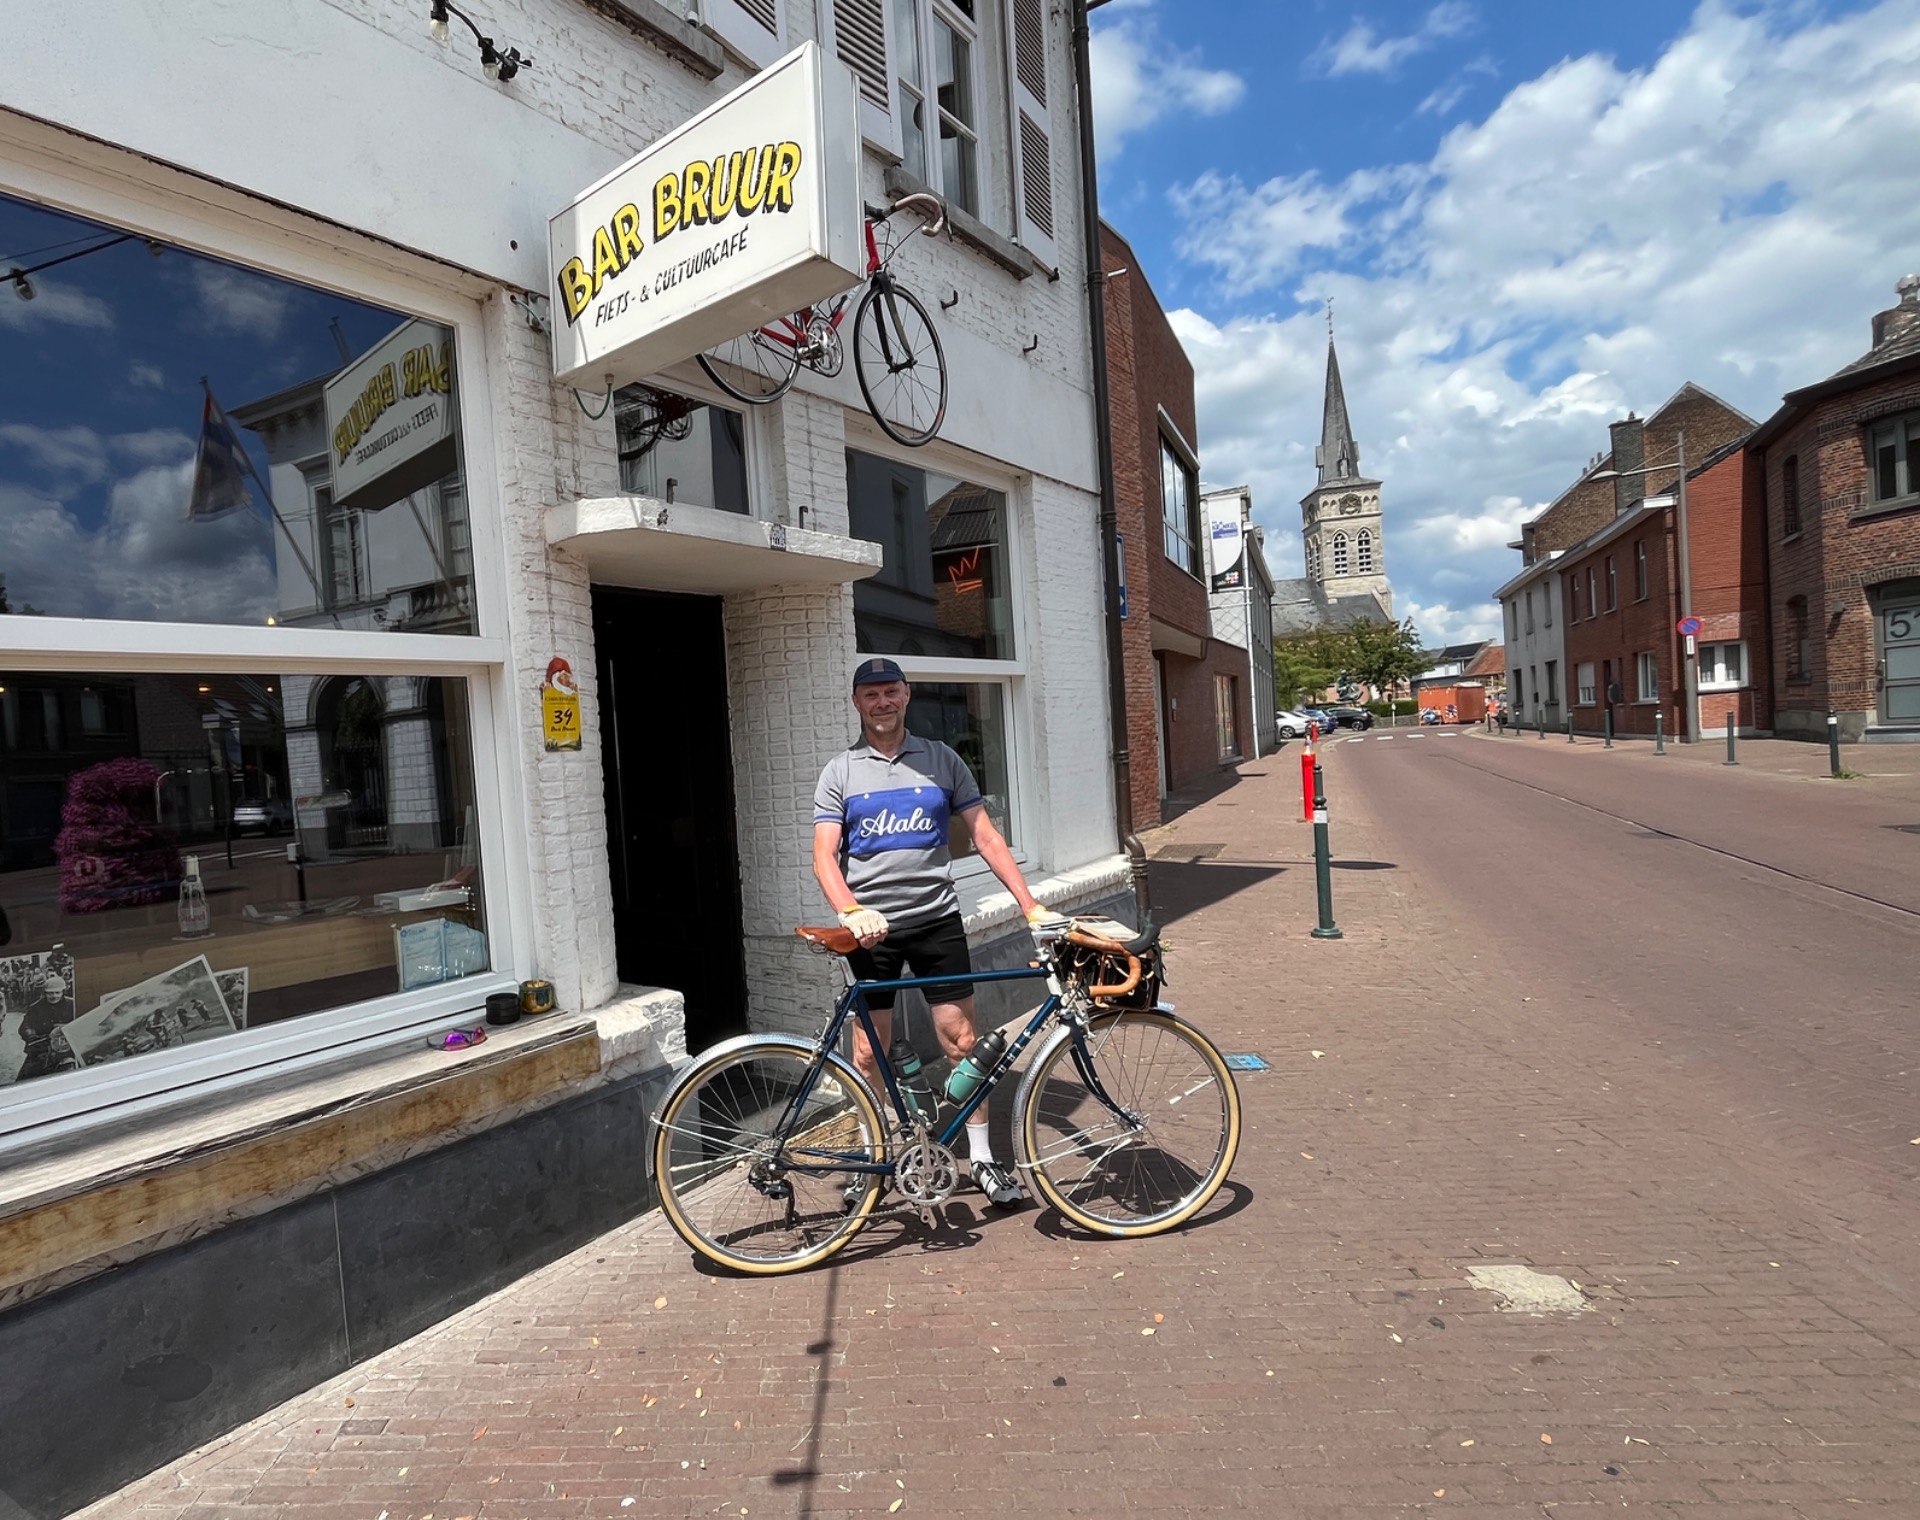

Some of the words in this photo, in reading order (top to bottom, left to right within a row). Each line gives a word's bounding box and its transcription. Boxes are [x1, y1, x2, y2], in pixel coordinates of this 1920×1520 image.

[557, 203, 644, 328] BAR
[652, 141, 802, 245] BRUUR
[639, 285, 651, 303] &
[1889, 610, 1920, 639] 5
[860, 806, 933, 838] Atala
